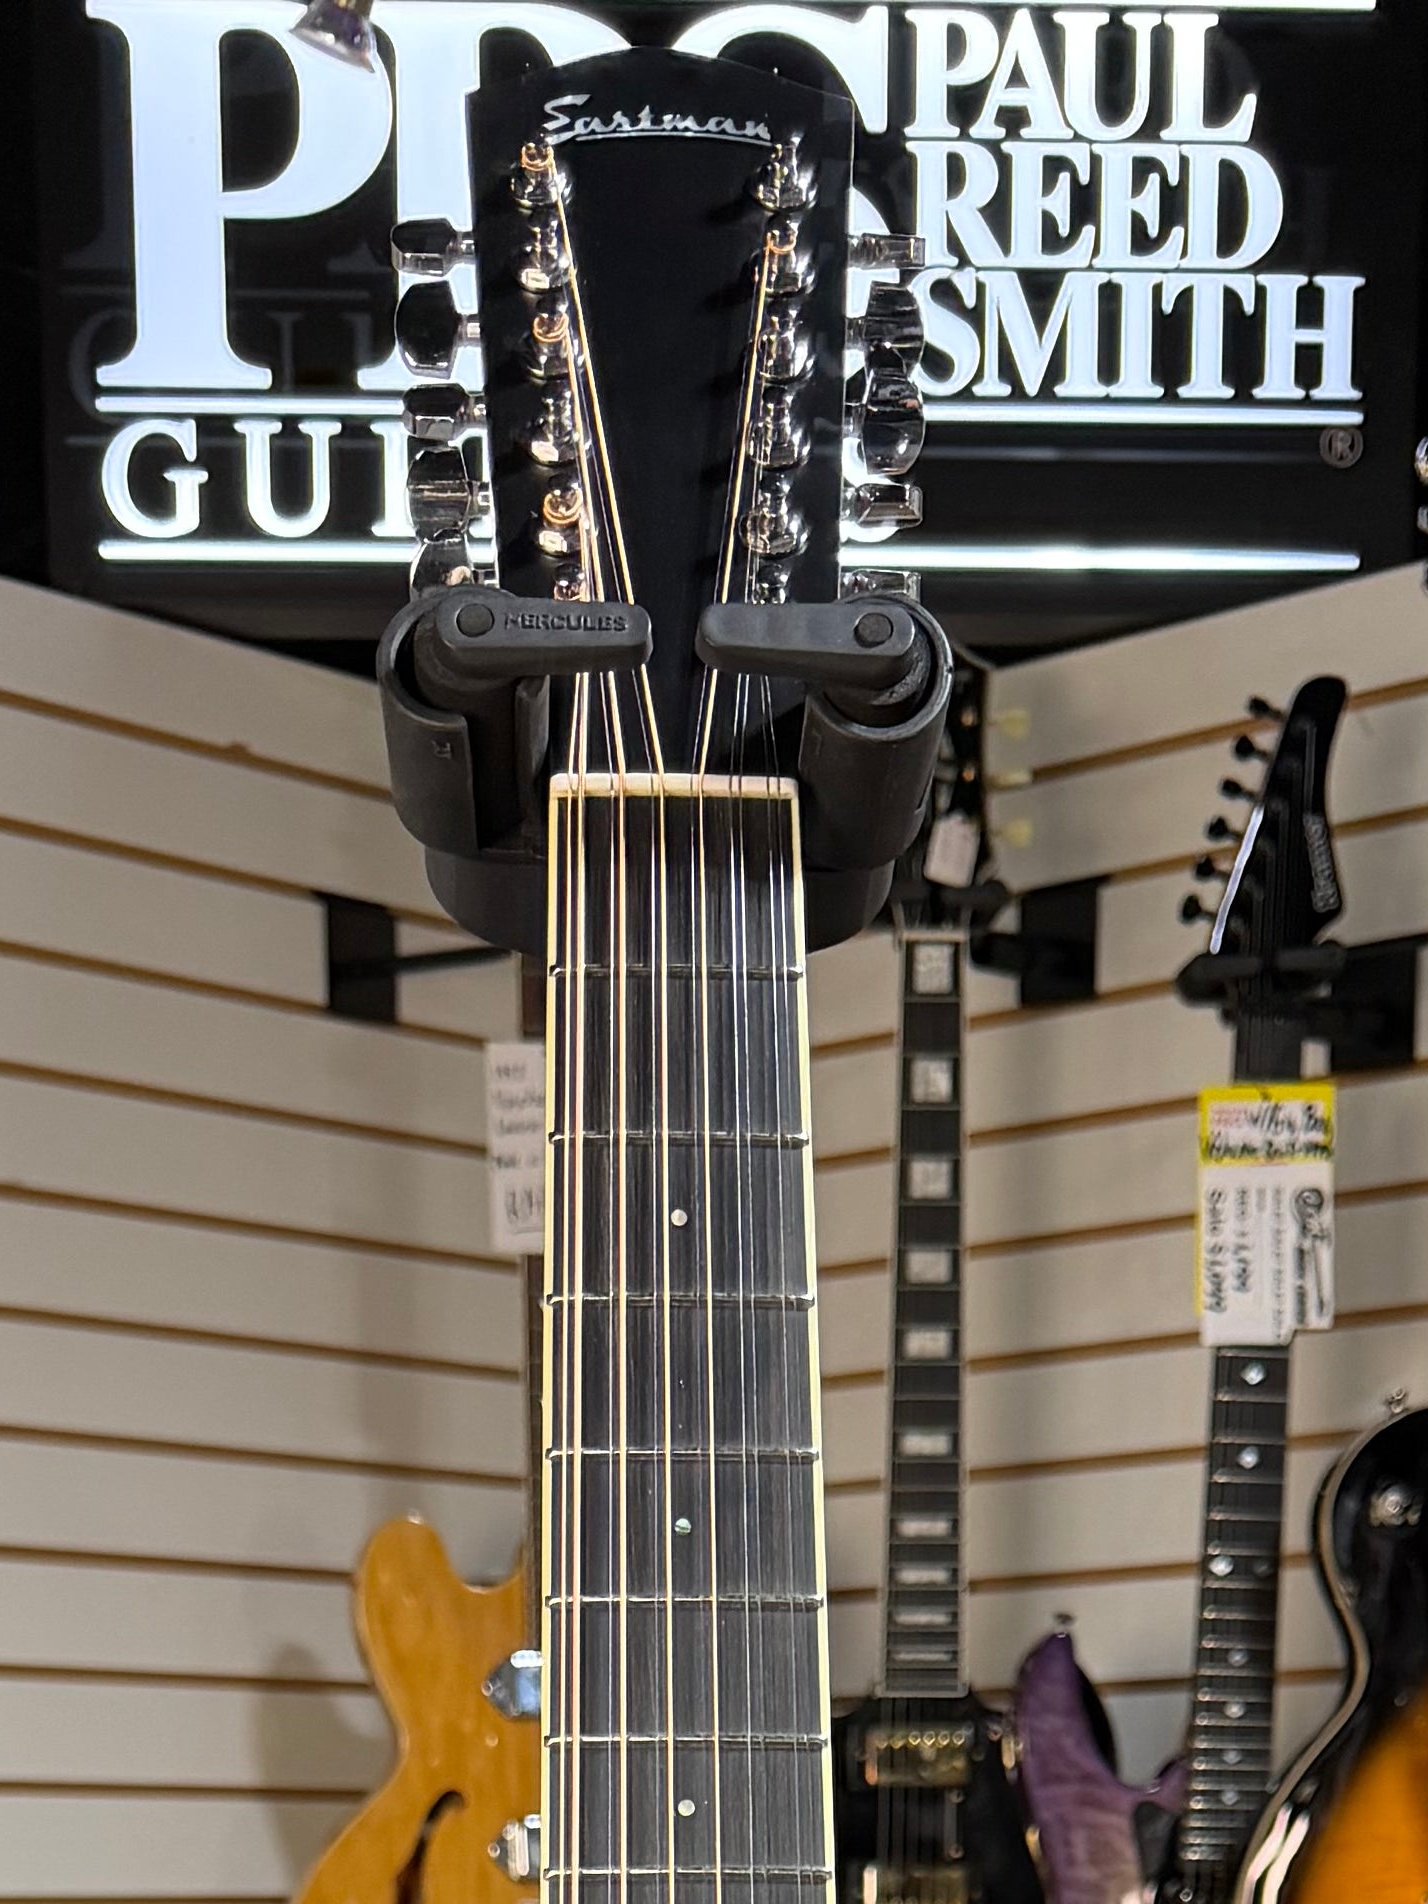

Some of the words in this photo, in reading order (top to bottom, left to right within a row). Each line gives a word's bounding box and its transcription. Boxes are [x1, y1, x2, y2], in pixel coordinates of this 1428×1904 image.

[543, 93, 774, 146] Eastman
[905, 7, 1258, 145] PAUL
[908, 143, 1284, 271] REED
[915, 273, 1366, 401] SMITH
[503, 611, 628, 633] HERCULES
